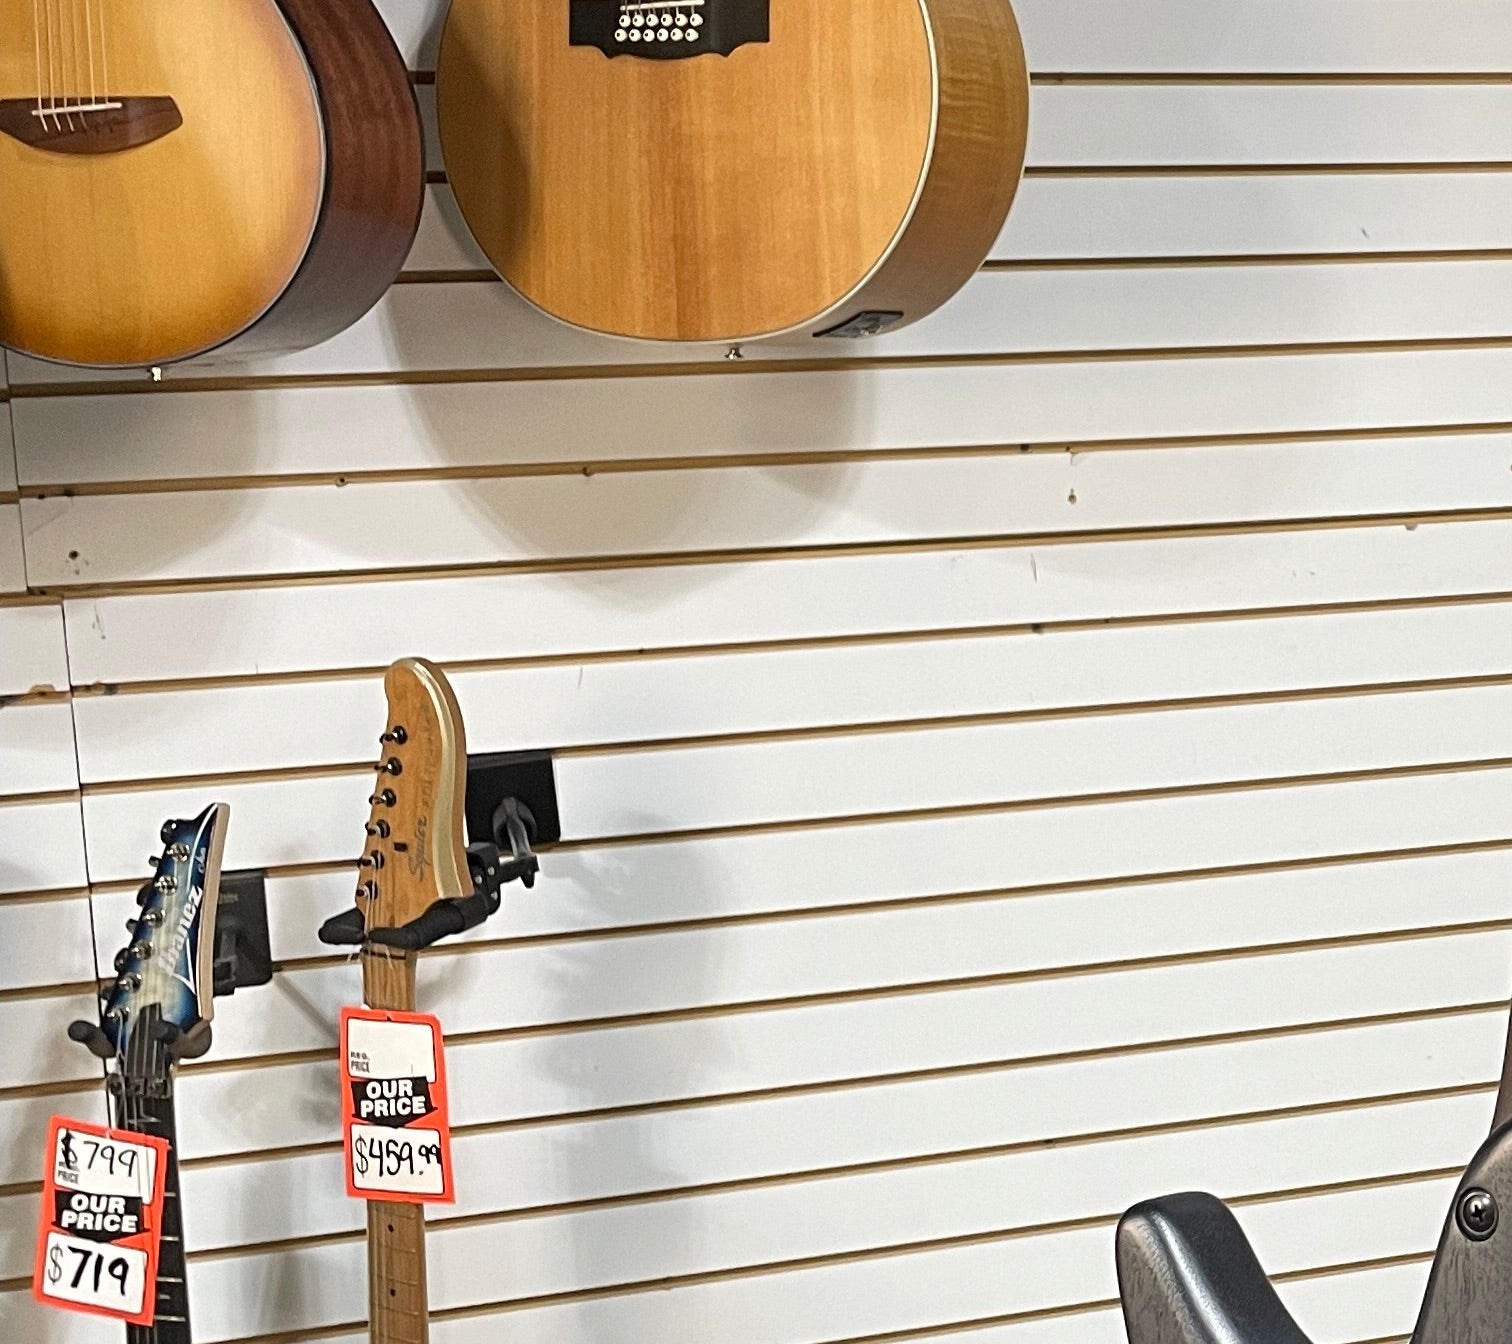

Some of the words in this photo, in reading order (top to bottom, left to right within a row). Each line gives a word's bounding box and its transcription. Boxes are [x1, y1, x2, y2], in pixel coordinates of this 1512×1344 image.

[156, 884, 204, 976] Ibanez
[366, 1079, 413, 1100] OUR
[360, 1095, 427, 1119] PRICE
[354, 1133, 442, 1179] $459.99
[70, 1192, 127, 1215] OUR
[60, 1209, 139, 1234] PRICE
[47, 1242, 130, 1297] $719
